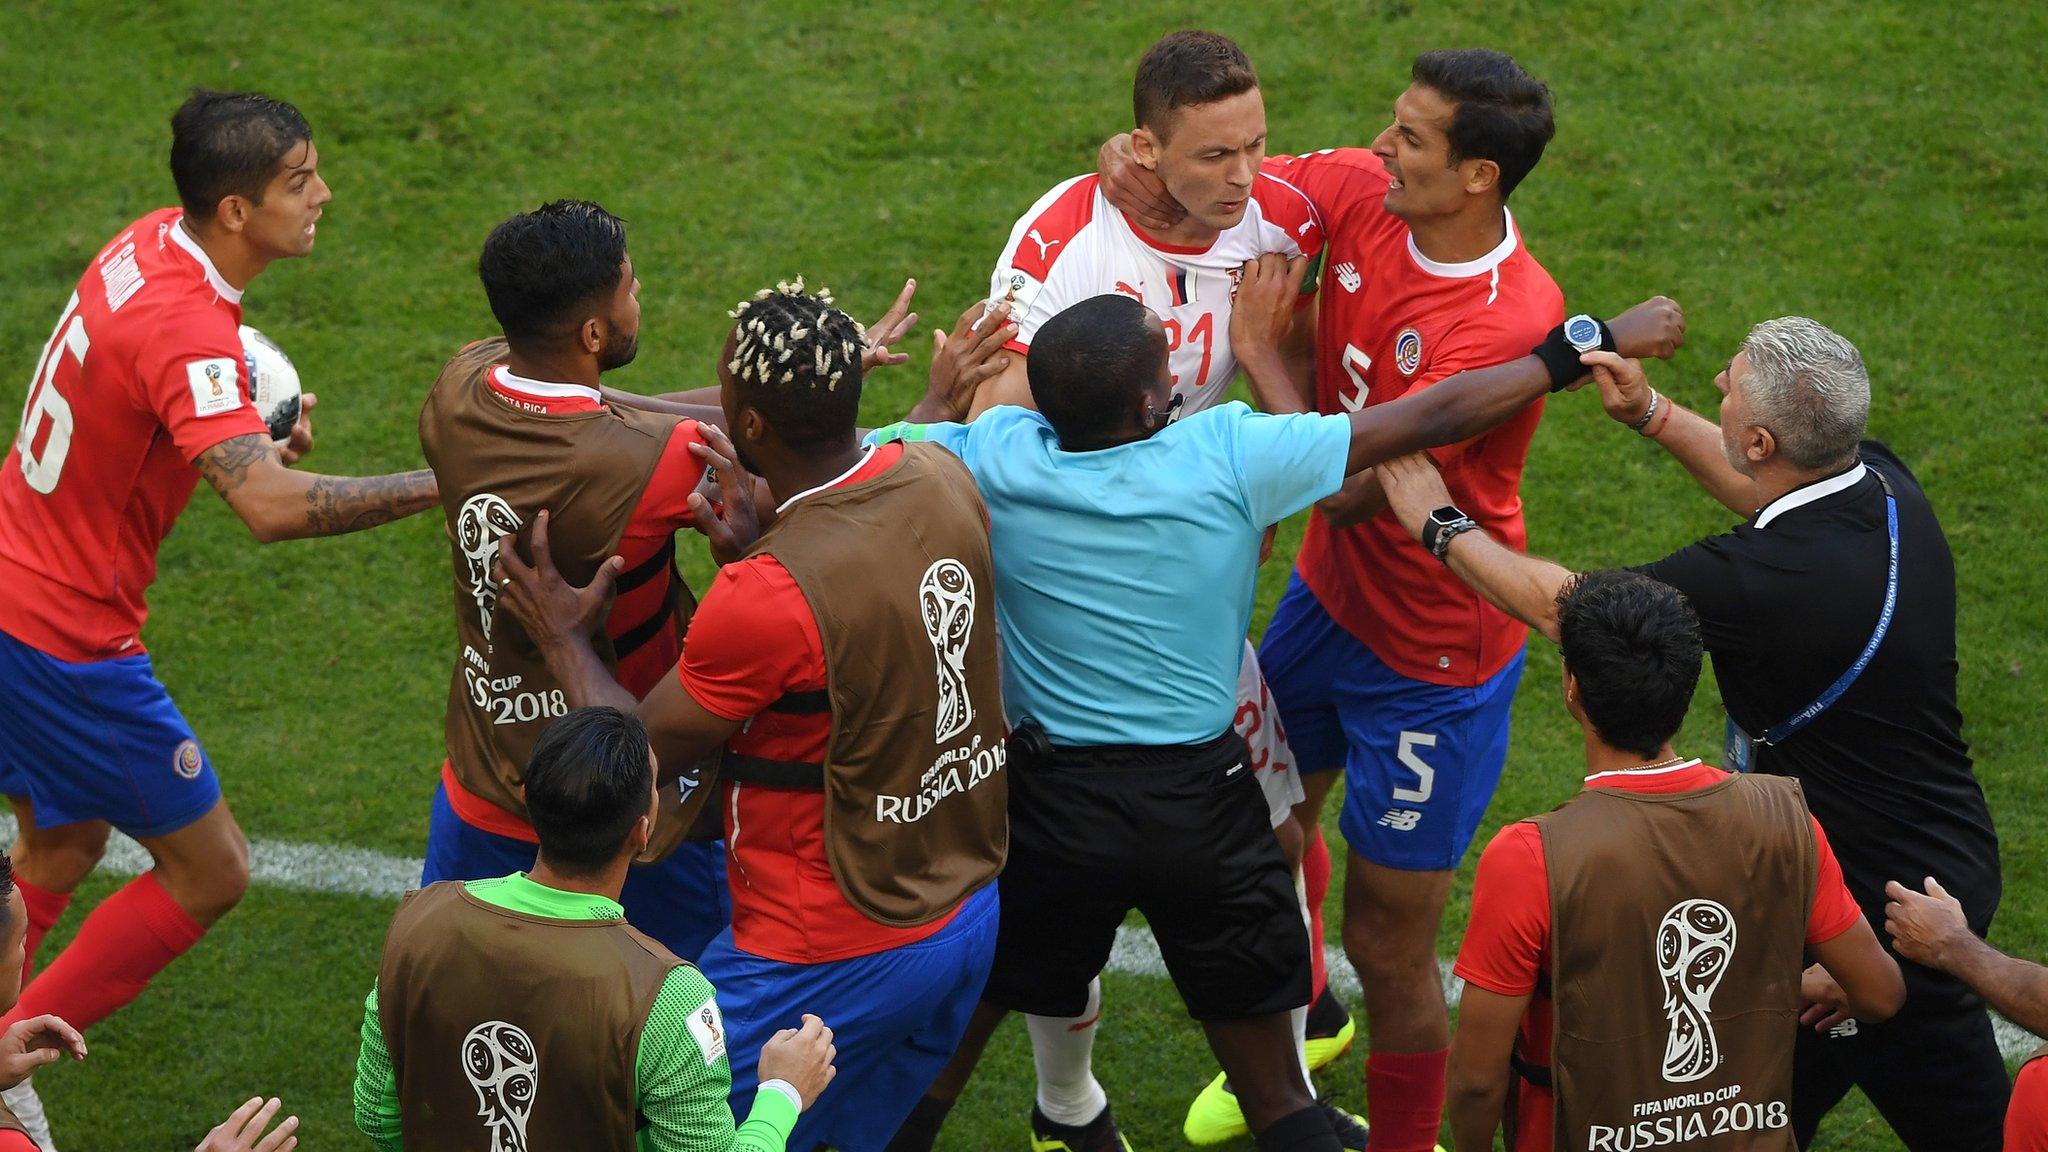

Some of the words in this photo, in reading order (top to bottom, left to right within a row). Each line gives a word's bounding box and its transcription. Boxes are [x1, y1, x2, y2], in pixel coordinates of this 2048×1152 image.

[1339, 342, 1372, 413] 5
[1876, 616, 1891, 638] CUP
[464, 645, 485, 671] FIFA
[1853, 637, 1879, 673] RUSSIA
[491, 675, 522, 693] CUP
[491, 689, 568, 725] 2018
[934, 746, 971, 773] WORLD
[1392, 731, 1438, 803] 5
[876, 767, 965, 824] RUSSIA
[967, 737, 1007, 790] 2018
[1633, 1103, 1662, 1117] FIFA
[1662, 1091, 1715, 1112] WORLD
[1715, 1084, 1741, 1101] CUP
[1588, 1111, 1708, 1152] RUSSIA
[1711, 1100, 1789, 1136] 2018
